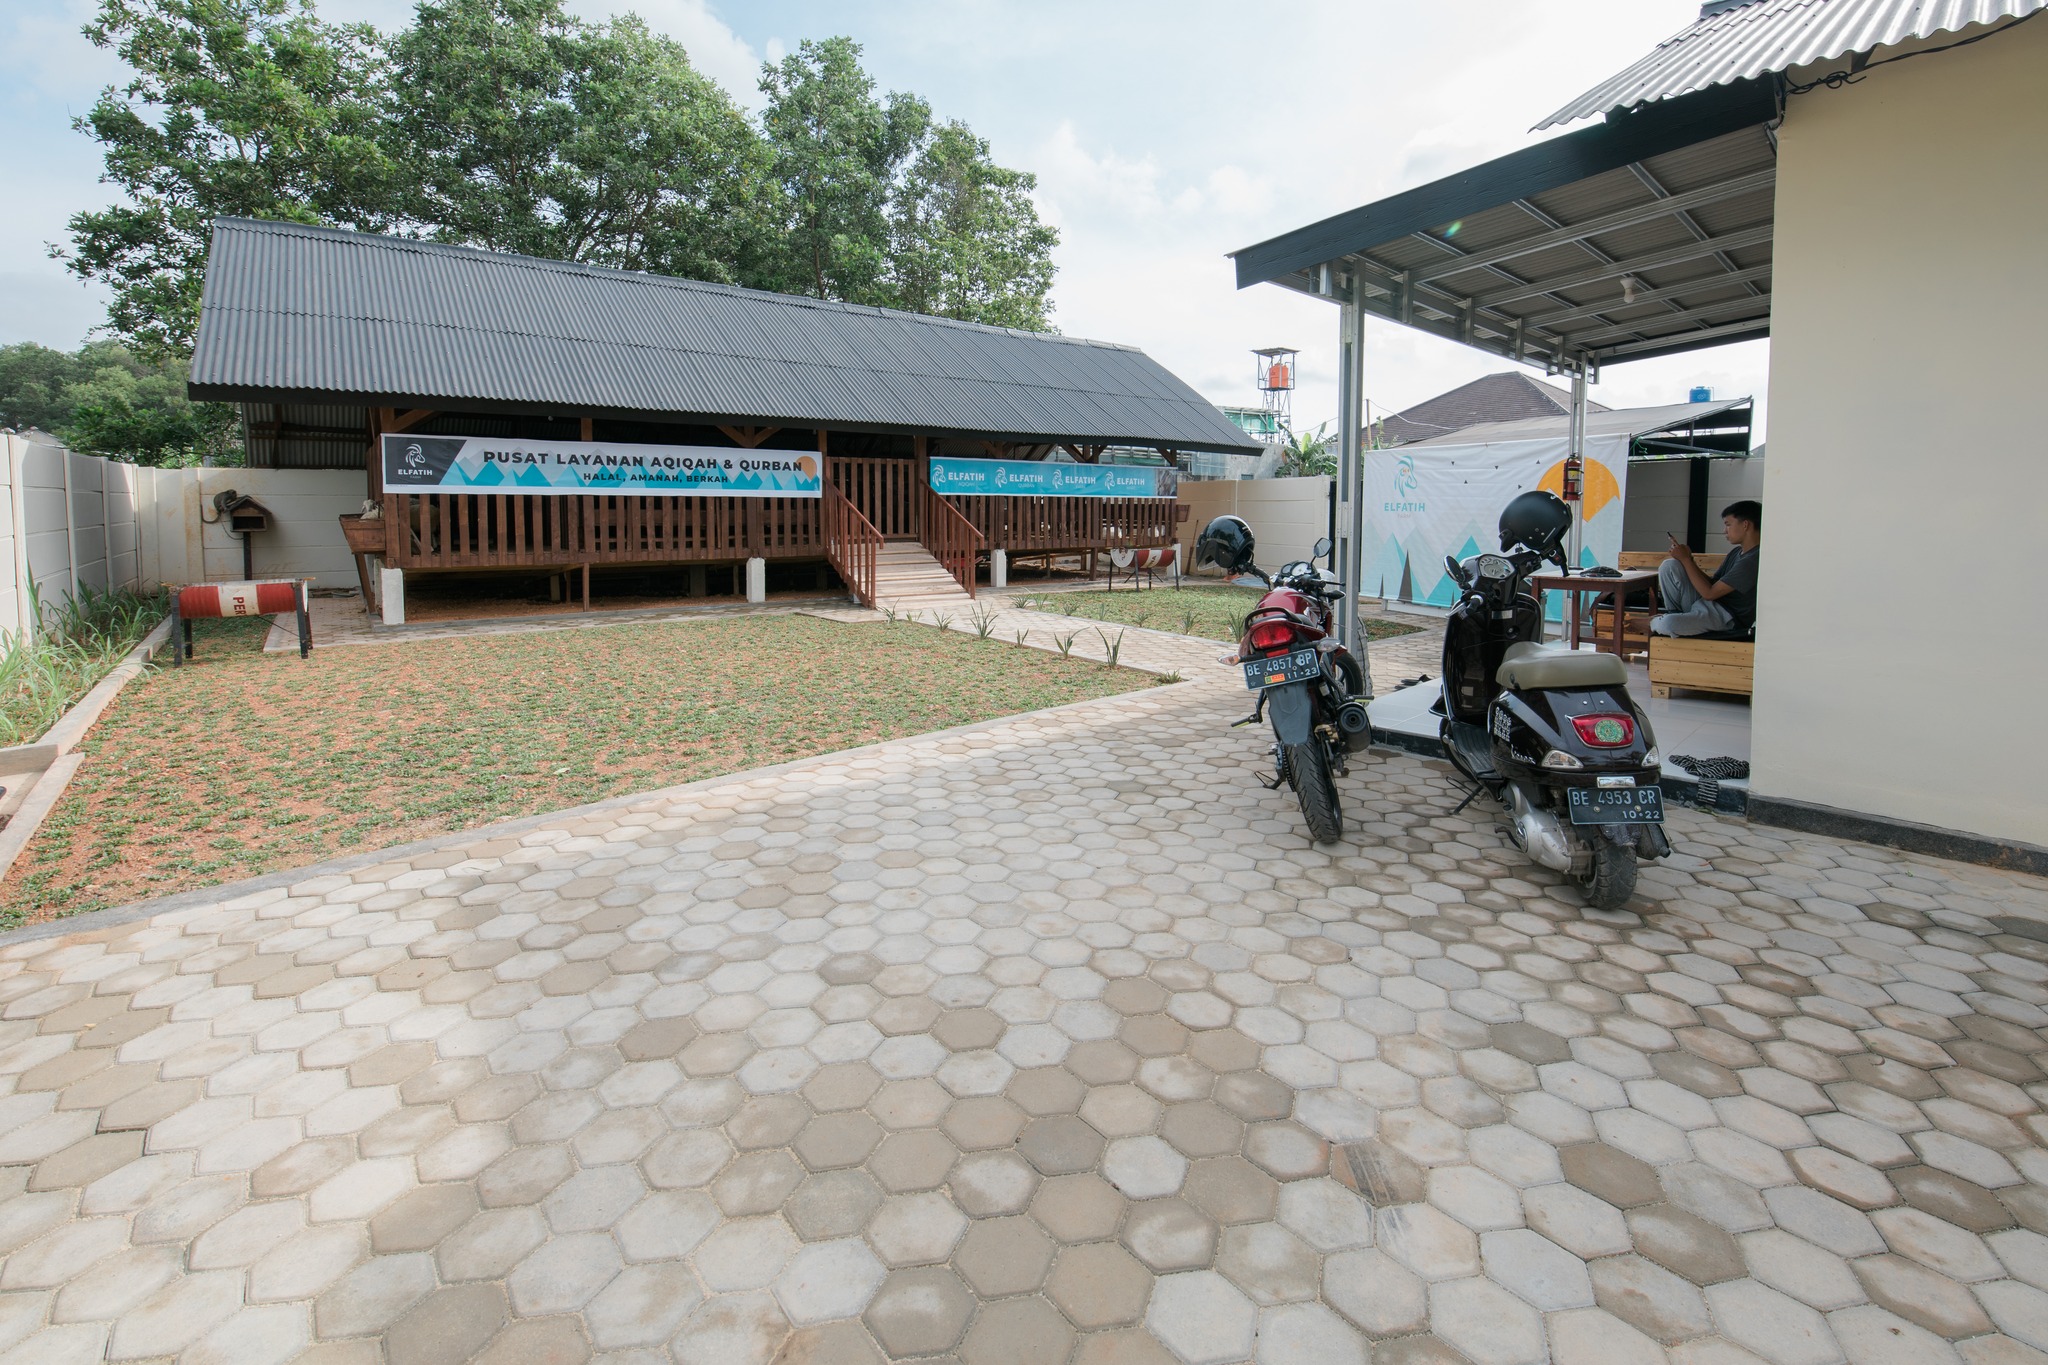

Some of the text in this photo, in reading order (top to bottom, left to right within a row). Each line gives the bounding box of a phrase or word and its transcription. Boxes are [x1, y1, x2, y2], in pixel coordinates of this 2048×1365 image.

[483, 451, 802, 472] PUSAT LAYANAN AQIQAH & QURBAN
[397, 468, 433, 476] ELFATIH
[948, 472, 985, 481] ELFATIH
[583, 473, 729, 483] HALAL, AMANAH, BERKAH
[1009, 474, 1043, 483] ELFATIH
[1065, 475, 1096, 484] ELFATIH
[1116, 477, 1145, 486] ELFATIH
[1384, 502, 1425, 512] ELFATIH
[1246, 664, 1260, 677] BE
[1266, 656, 1292, 672] 4857
[1296, 653, 1312, 667] BP
[1571, 790, 1656, 806] BE 4953 CR
